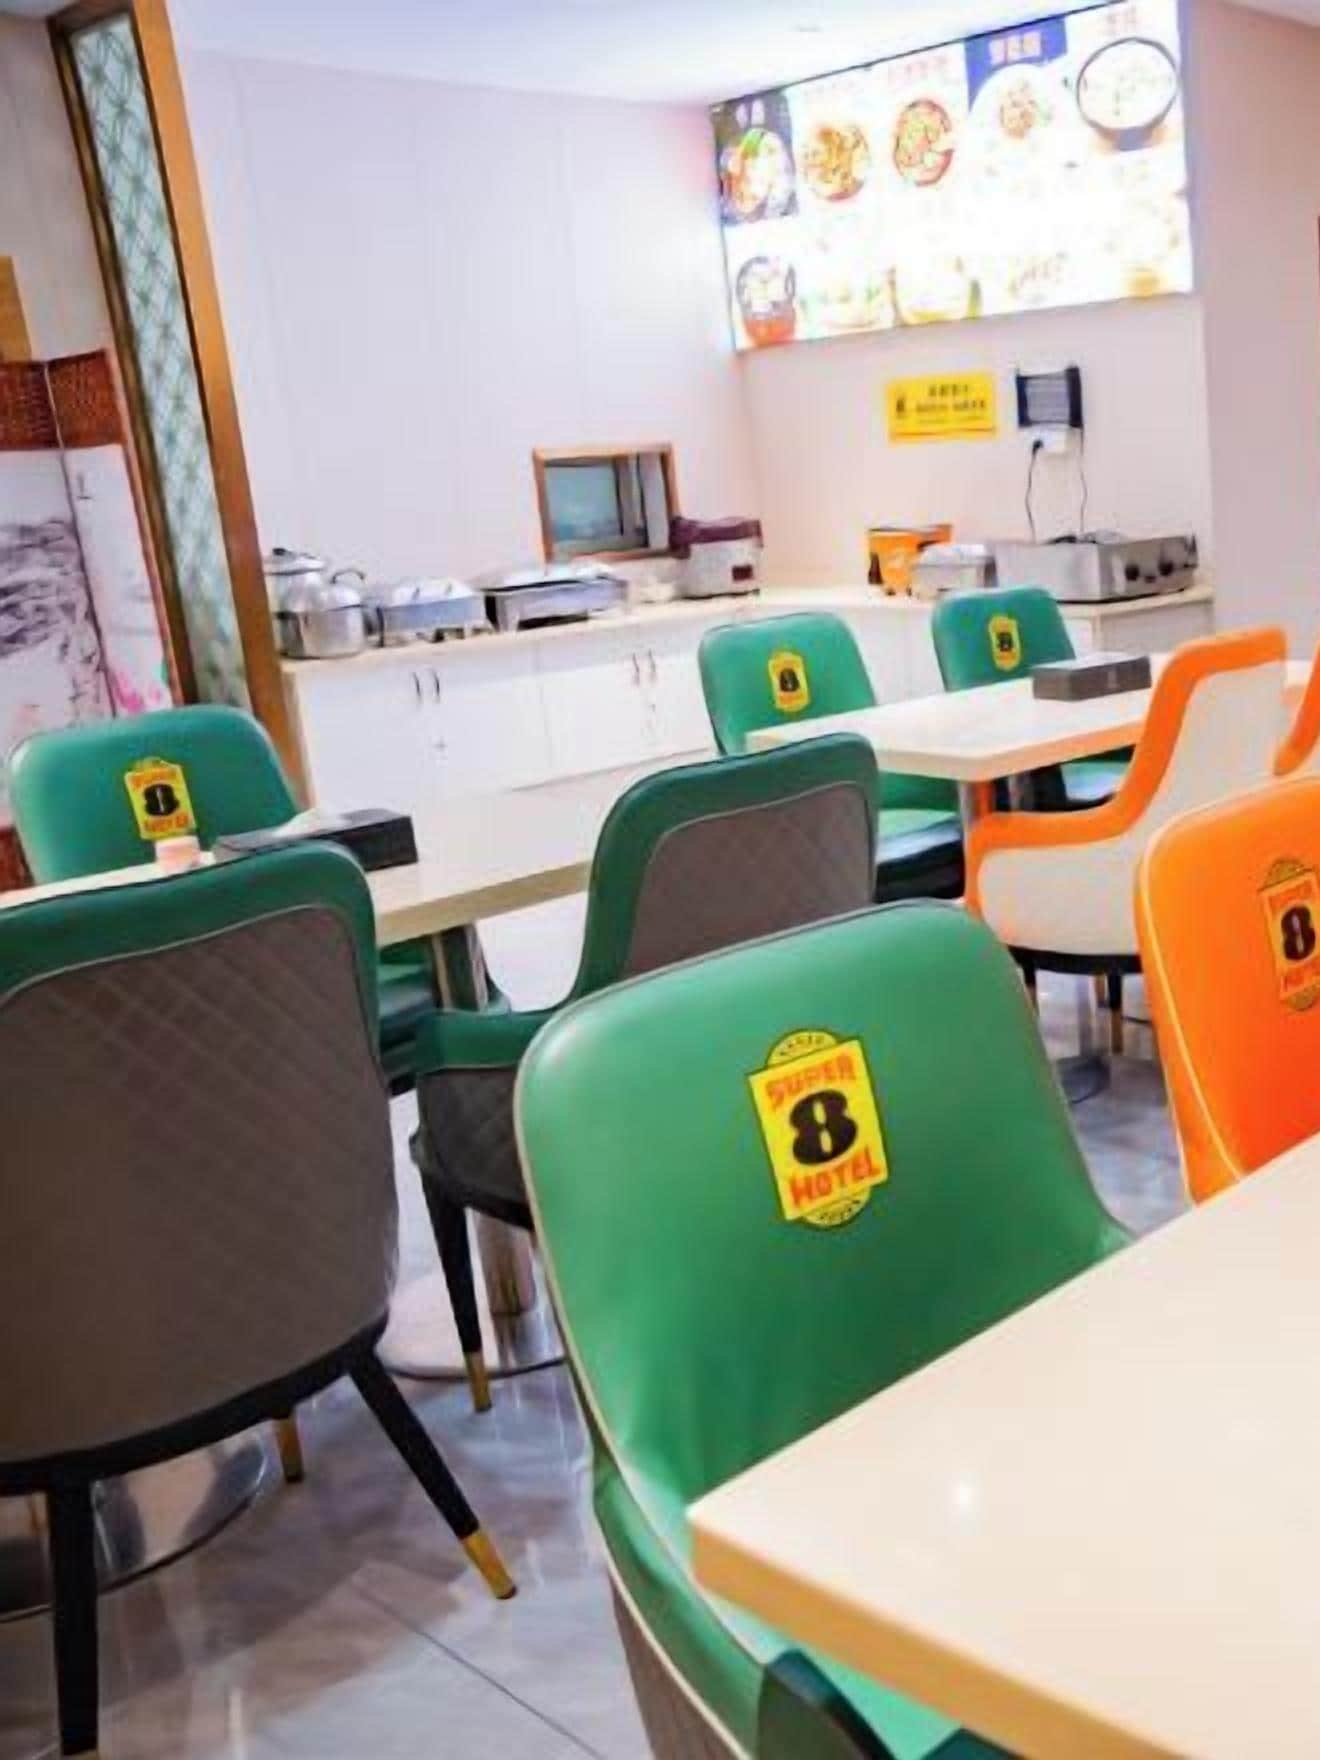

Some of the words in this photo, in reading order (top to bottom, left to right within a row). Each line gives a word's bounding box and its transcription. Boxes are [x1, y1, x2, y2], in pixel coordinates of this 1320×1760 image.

[144, 784, 179, 816] 8
[1281, 906, 1316, 961] 8
[766, 1053, 857, 1112] SUPER
[789, 1089, 858, 1166] 8
[789, 1145, 881, 1208] HOTEL
